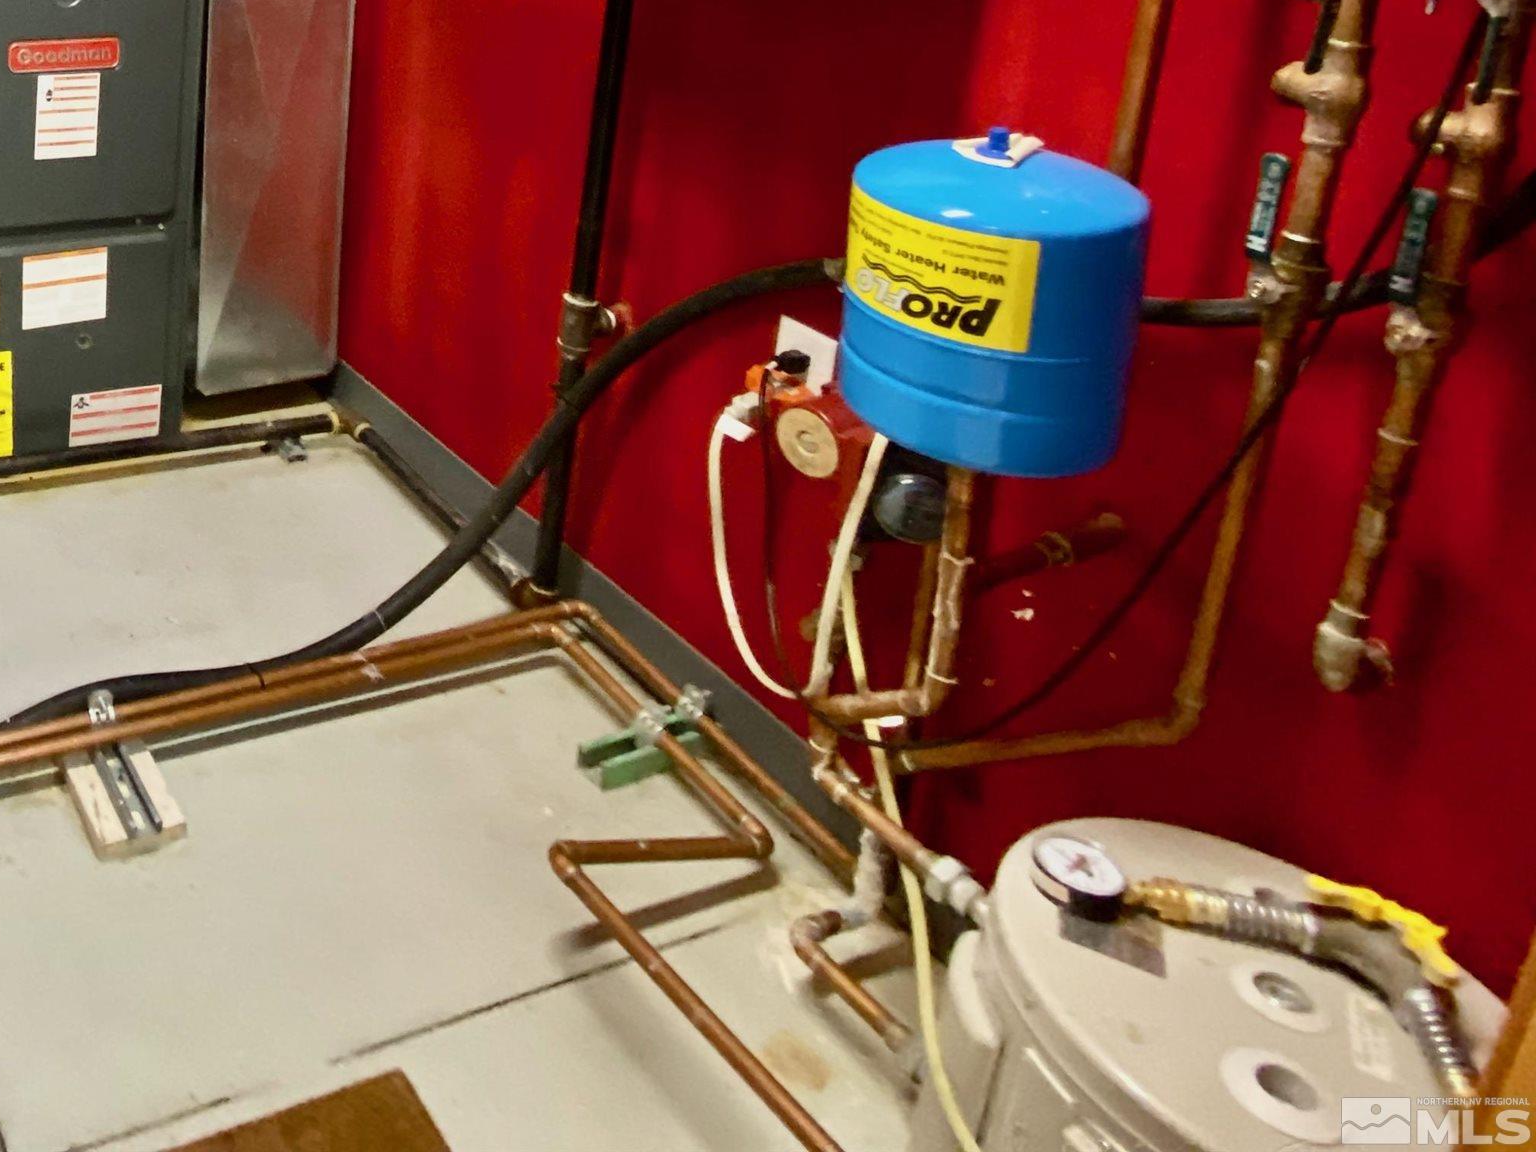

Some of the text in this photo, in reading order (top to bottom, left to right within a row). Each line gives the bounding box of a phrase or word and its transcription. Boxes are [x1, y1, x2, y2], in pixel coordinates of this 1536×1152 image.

[17, 47, 112, 65] Goodman
[896, 247, 947, 274] Heater
[952, 265, 1006, 286] Water
